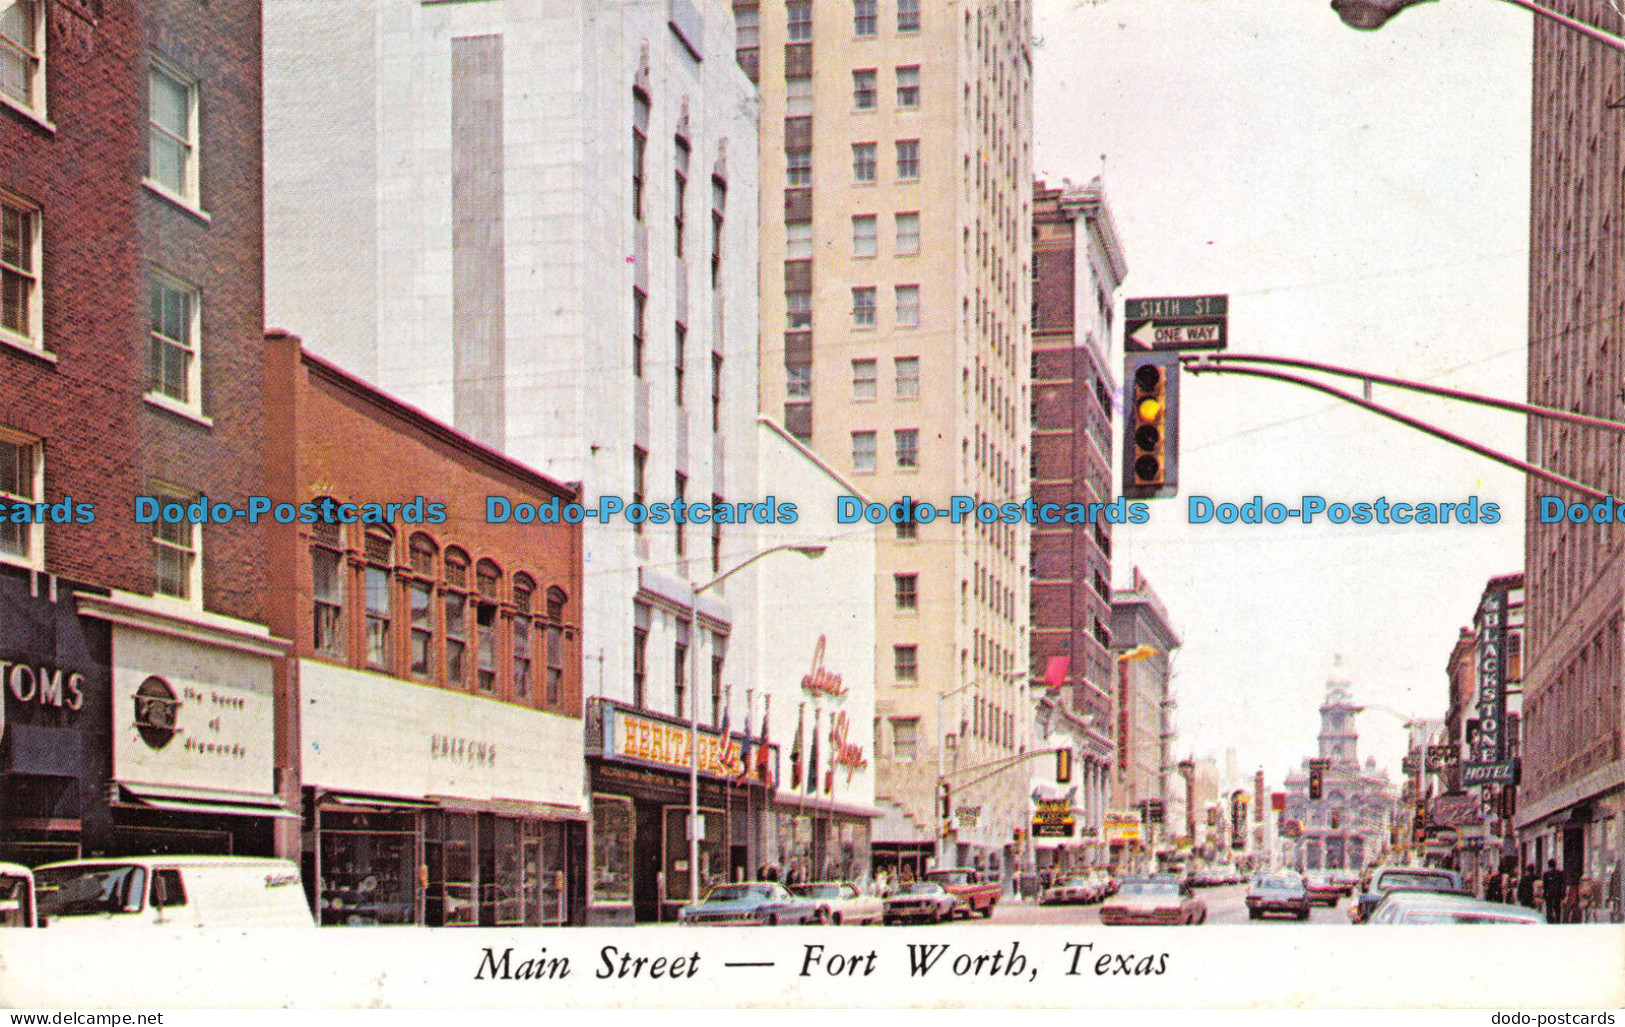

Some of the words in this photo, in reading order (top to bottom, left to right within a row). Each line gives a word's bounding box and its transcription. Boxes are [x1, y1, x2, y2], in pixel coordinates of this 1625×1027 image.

[1140, 300, 1180, 317] SIXTH
[1194, 298, 1211, 315] ST
[1155, 327, 1183, 342] ONE
[1187, 326, 1214, 341] WAY
[1481, 613, 1499, 763] BLACKSTONE
[624, 715, 720, 774] HERITAGE
[1465, 765, 1512, 781] HOTEL
